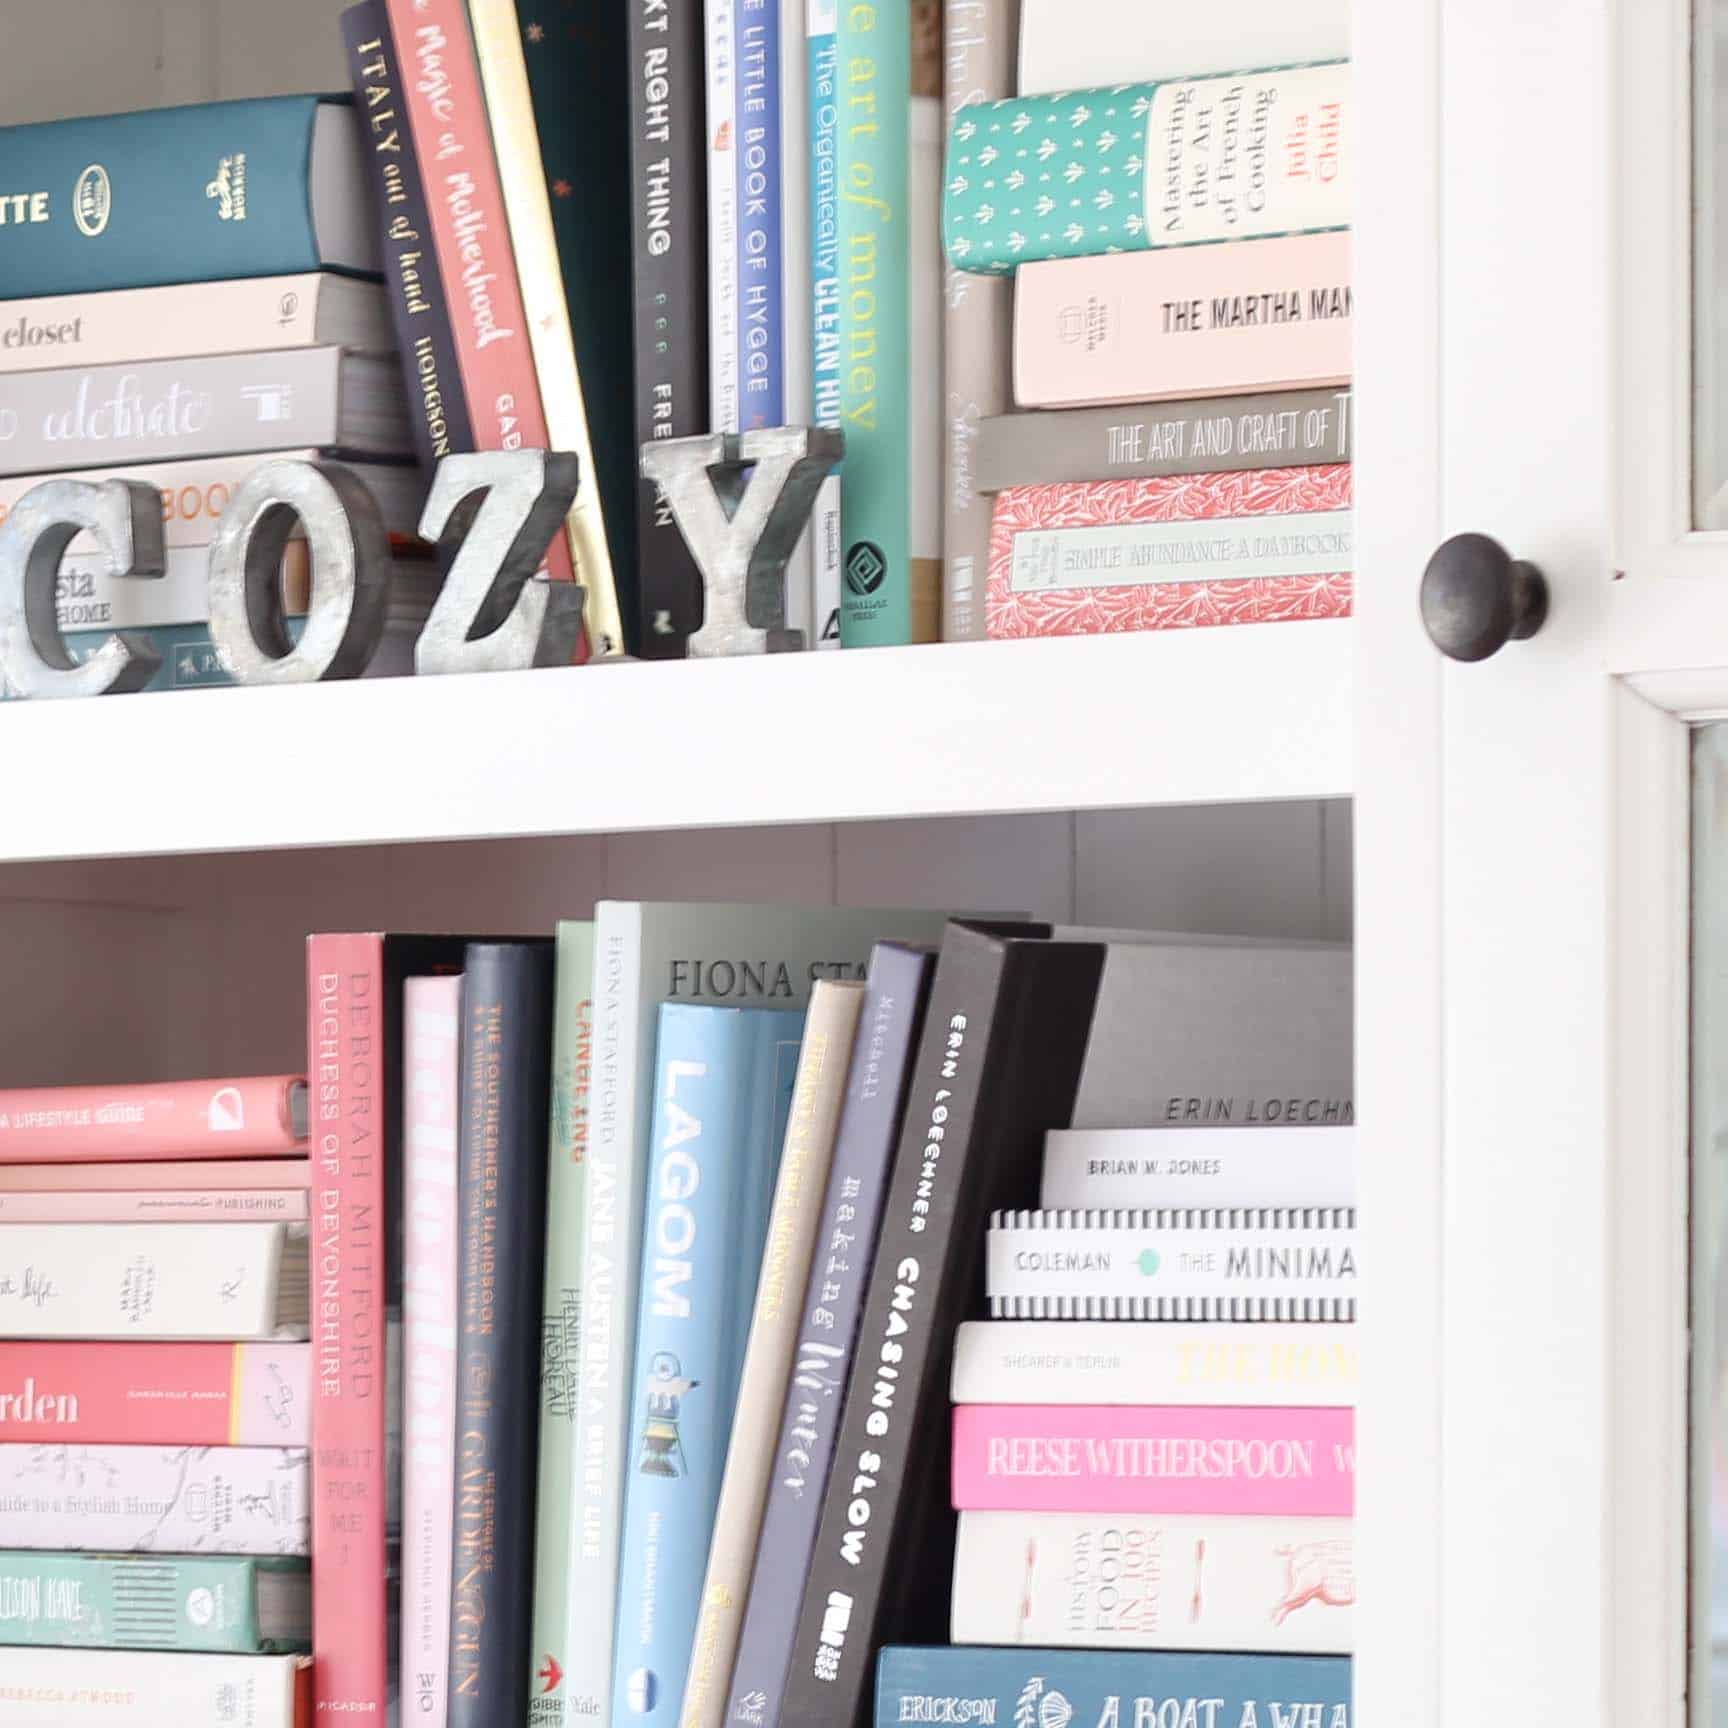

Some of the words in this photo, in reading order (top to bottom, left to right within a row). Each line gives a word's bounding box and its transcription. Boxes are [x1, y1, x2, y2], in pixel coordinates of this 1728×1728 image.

[357, 38, 403, 153] ITALY
[414, 24, 457, 120] Magic
[644, 47, 670, 142] RIGHT
[744, 26, 767, 113] LITTLE
[846, 56, 880, 144] art
[433, 132, 464, 161] of
[744, 127, 768, 216] BOOK
[1163, 87, 1195, 233] Mastering
[1191, 104, 1213, 153] Art
[1215, 85, 1246, 183] French
[1245, 87, 1279, 215] Cooking
[1283, 113, 1313, 183] Julia
[1314, 102, 1344, 185] Child
[381, 162, 410, 205] out
[645, 157, 671, 256] THING
[840, 160, 893, 223] of
[1189, 161, 1210, 209] the
[1215, 192, 1238, 226] of
[387, 215, 420, 243] of
[445, 172, 514, 350] Motherhood
[745, 231, 768, 271] OF
[398, 250, 432, 315] hand
[1162, 301, 1203, 335] THE
[1209, 290, 1300, 331] MARTHA
[0, 315, 84, 352] closet
[744, 286, 769, 394] HYGGE
[845, 232, 880, 432] money
[1107, 425, 1145, 465] THE
[1147, 422, 1185, 462] ART
[1190, 418, 1232, 459] AND
[1238, 413, 1300, 455] CRAFT
[1304, 409, 1331, 449] OF
[606, 936, 625, 1011] FIONA
[667, 959, 794, 998] FIONA
[318, 972, 342, 1122] DUCHESS
[487, 1006, 501, 1045] THE
[859, 996, 897, 1102] Mitchell
[938, 1015, 969, 1078] ERIN
[0, 1113, 11, 1129] A
[15, 1108, 92, 1129] LIFESTYLE
[348, 971, 374, 1181] DEBORAH
[598, 1019, 620, 1146] STAFFORD
[1165, 1098, 1233, 1122] ERIN
[318, 1133, 342, 1176] OF
[483, 1053, 499, 1209] SOUTHERNER'S
[908, 1089, 954, 1234] LOECHNER
[1087, 1159, 1139, 1176] BRIAN
[1145, 1158, 1162, 1175] W.
[1168, 1158, 1224, 1176] JONES
[590, 1158, 616, 1243] JANE
[653, 1059, 707, 1318] LAGOM
[318, 1187, 342, 1399] DEVONSHIRE
[479, 1215, 497, 1337] HANDBOOK
[810, 1176, 866, 1330] making
[1014, 1251, 1112, 1273] COLEMAN
[1177, 1251, 1217, 1273] THE
[349, 1202, 374, 1401] MITFORD
[560, 1287, 582, 1351] HENRY
[584, 1253, 614, 1390] AUSTEN
[866, 1257, 920, 1436] CHASING
[784, 1342, 847, 1500] Winter
[987, 1437, 1081, 1476] REESE
[1085, 1438, 1314, 1480] WITHERSPOON
[837, 1449, 883, 1566] SLOW
[1096, 1530, 1122, 1632] FOOD
[1119, 1599, 1139, 1632] IN
[898, 1694, 997, 1727] ERICKSON
